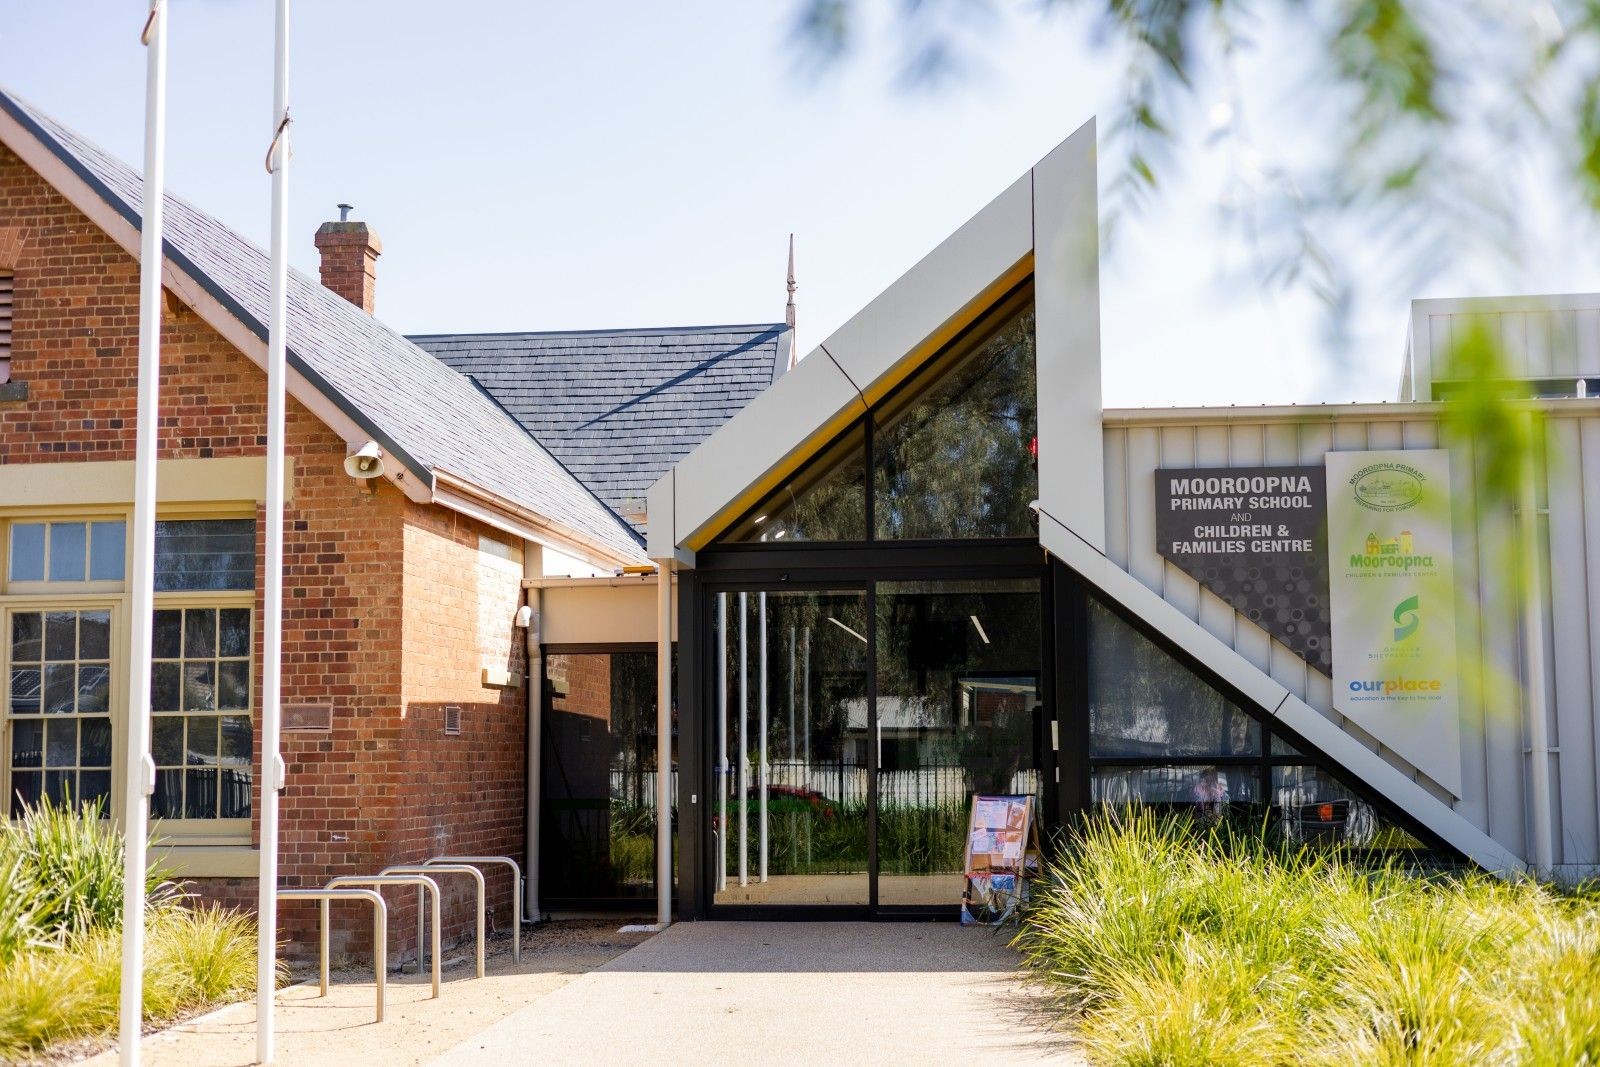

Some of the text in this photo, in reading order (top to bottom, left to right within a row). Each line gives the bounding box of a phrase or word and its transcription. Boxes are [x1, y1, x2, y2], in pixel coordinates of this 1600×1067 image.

[1395, 463, 1427, 482] PRIMARY
[1170, 476, 1312, 495] MOOROOPNA
[1171, 496, 1312, 510] PRIMARY SCHOOL
[1230, 512, 1252, 522] AND
[1194, 524, 1289, 538] CHILDREN &
[1172, 539, 1313, 554] FAMILIES CENTRE
[1350, 554, 1434, 571] Mooroopna
[1349, 676, 1441, 695] ourplace
